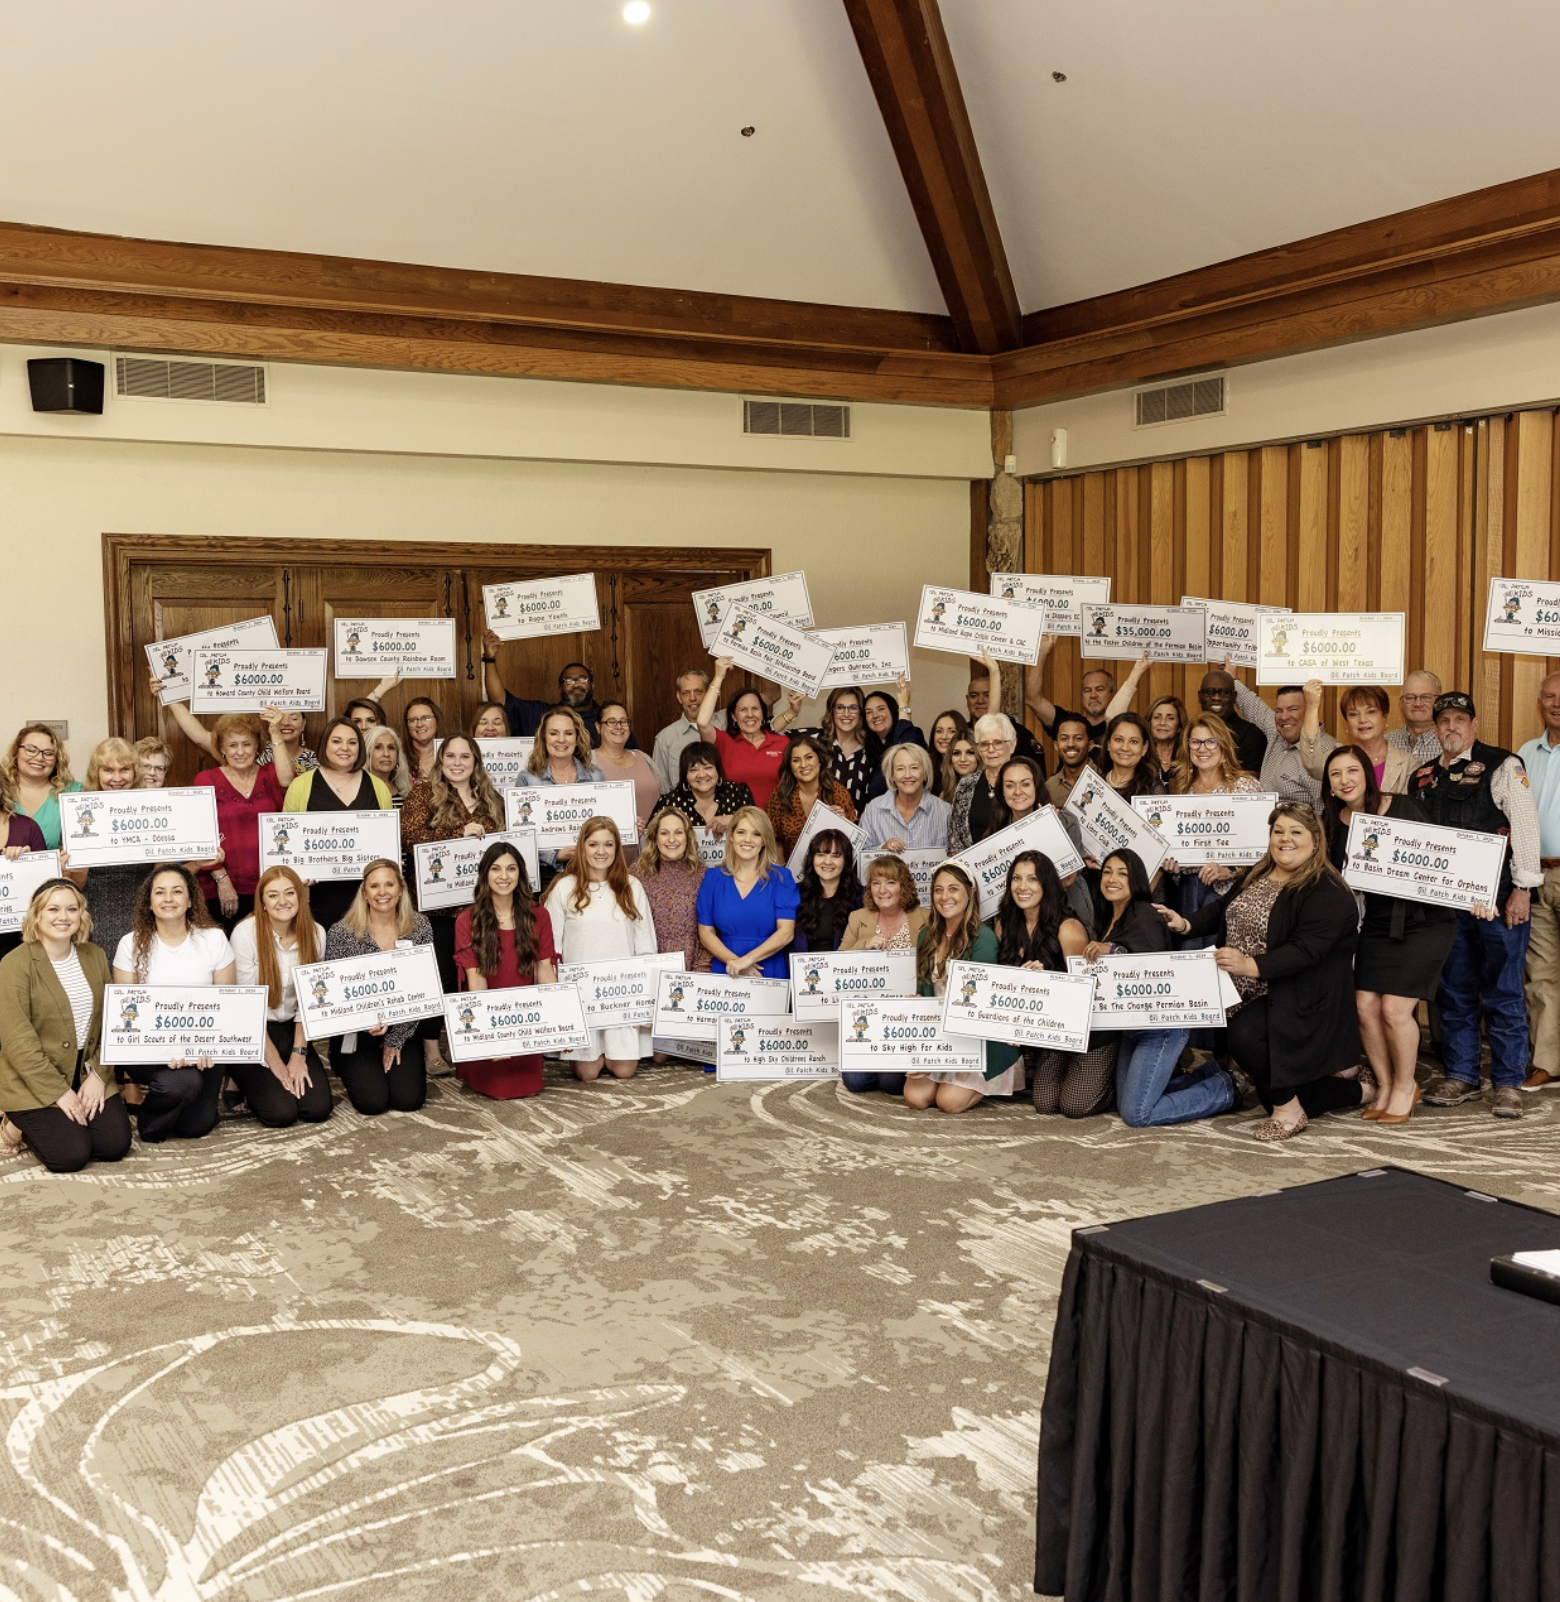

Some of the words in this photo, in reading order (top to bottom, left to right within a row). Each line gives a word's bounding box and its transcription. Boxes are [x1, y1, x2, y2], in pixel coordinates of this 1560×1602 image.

[520, 600, 560, 614] $6000.00
[957, 614, 1002, 631] $6000.00
[1116, 626, 1171, 638] $35,000.00
[1209, 624, 1249, 638] $6000.00
[1302, 629, 1328, 638] Proudly
[1332, 629, 1361, 637] Presents
[372, 641, 416, 652] $6000.00
[753, 636, 793, 660] $6000.00
[1303, 641, 1356, 654] $6000.00
[233, 663, 258, 671] Proudly
[1298, 659, 1317, 667] CASA
[1321, 659, 1328, 667] of
[1332, 659, 1349, 667] West
[1353, 659, 1374, 667] Texas
[234, 674, 283, 686] $6000.00
[109, 806, 137, 815] Proudly
[141, 805, 172, 813] Presents
[1176, 810, 1202, 819] Proudly
[112, 817, 168, 833] $6000.00
[303, 827, 328, 835] Proudly
[1095, 812, 1129, 851] $6000.00
[1177, 822, 1230, 835] $6000.00
[304, 838, 355, 851] $6000.00
[1194, 839, 1211, 847] First
[1216, 838, 1229, 846] Tee
[1394, 836, 1422, 849] Proudly
[1426, 841, 1456, 854] Presents
[293, 856, 304, 865] Big
[342, 855, 353, 864] Big
[1392, 849, 1449, 870] $6000.00
[1352, 862, 1360, 870] to
[1364, 862, 1383, 873] Basin
[1387, 867, 1410, 877] Dream
[1413, 872, 1438, 883] Center
[1457, 879, 1488, 892] Orphans
[340, 972, 366, 983] Proudly
[368, 967, 397, 978] Presents
[593, 974, 617, 983] Proudly
[620, 972, 647, 980] Presents
[1113, 970, 1140, 980] Proudly
[1144, 970, 1174, 978] Presents
[344, 980, 395, 1000] $6000.00
[835, 977, 885, 991] $6000.00
[991, 981, 1017, 993] Proudly
[1021, 985, 1050, 996] Presents
[1117, 983, 1171, 997] $6000.00
[595, 984, 643, 999] $6000.00
[697, 987, 721, 997] Proudly
[724, 989, 751, 998] Presents
[155, 1002, 184, 1012] Proudly
[188, 1002, 220, 1010] Presents
[330, 1005, 353, 1015] Midland
[386, 996, 405, 1005] Rehab
[407, 992, 425, 1001] Center
[487, 1003, 511, 1011] Proudly
[515, 1000, 542, 1008] Presents
[600, 1002, 630, 1010] Buckner
[697, 998, 745, 1013] $6000.00
[990, 993, 1043, 1011] $6000.00
[1099, 1003, 1107, 1011] Be
[1111, 1002, 1124, 1010] The
[1127, 1002, 1153, 1012] Change
[1156, 1000, 1184, 1009] Permian
[1188, 999, 1208, 1008] Basin
[155, 1015, 214, 1030] $6000.00
[490, 1012, 540, 1028] $6000.00
[882, 1014, 908, 1023] Proudly
[978, 1010, 1009, 1022] Guardians
[1013, 1015, 1021, 1023] of
[1023, 1016, 1034, 1025] the
[1037, 1018, 1065, 1029] Children
[117, 1036, 124, 1044] to
[127, 1035, 140, 1044] Girl
[144, 1035, 165, 1043] Scouts
[169, 1034, 177, 1043] of
[180, 1034, 191, 1043] the
[194, 1035, 215, 1043] Desert
[219, 1034, 252, 1043] Southwest
[758, 1028, 782, 1037] Proudly
[883, 1026, 936, 1040] $6000.00
[185, 1048, 194, 1056] Oil
[198, 1048, 218, 1056] Patch
[760, 1039, 808, 1052] $6000.00
[870, 1044, 878, 1052] to
[882, 1044, 896, 1053] Sky
[900, 1044, 917, 1053] High
[937, 1043, 952, 1051] Kids
